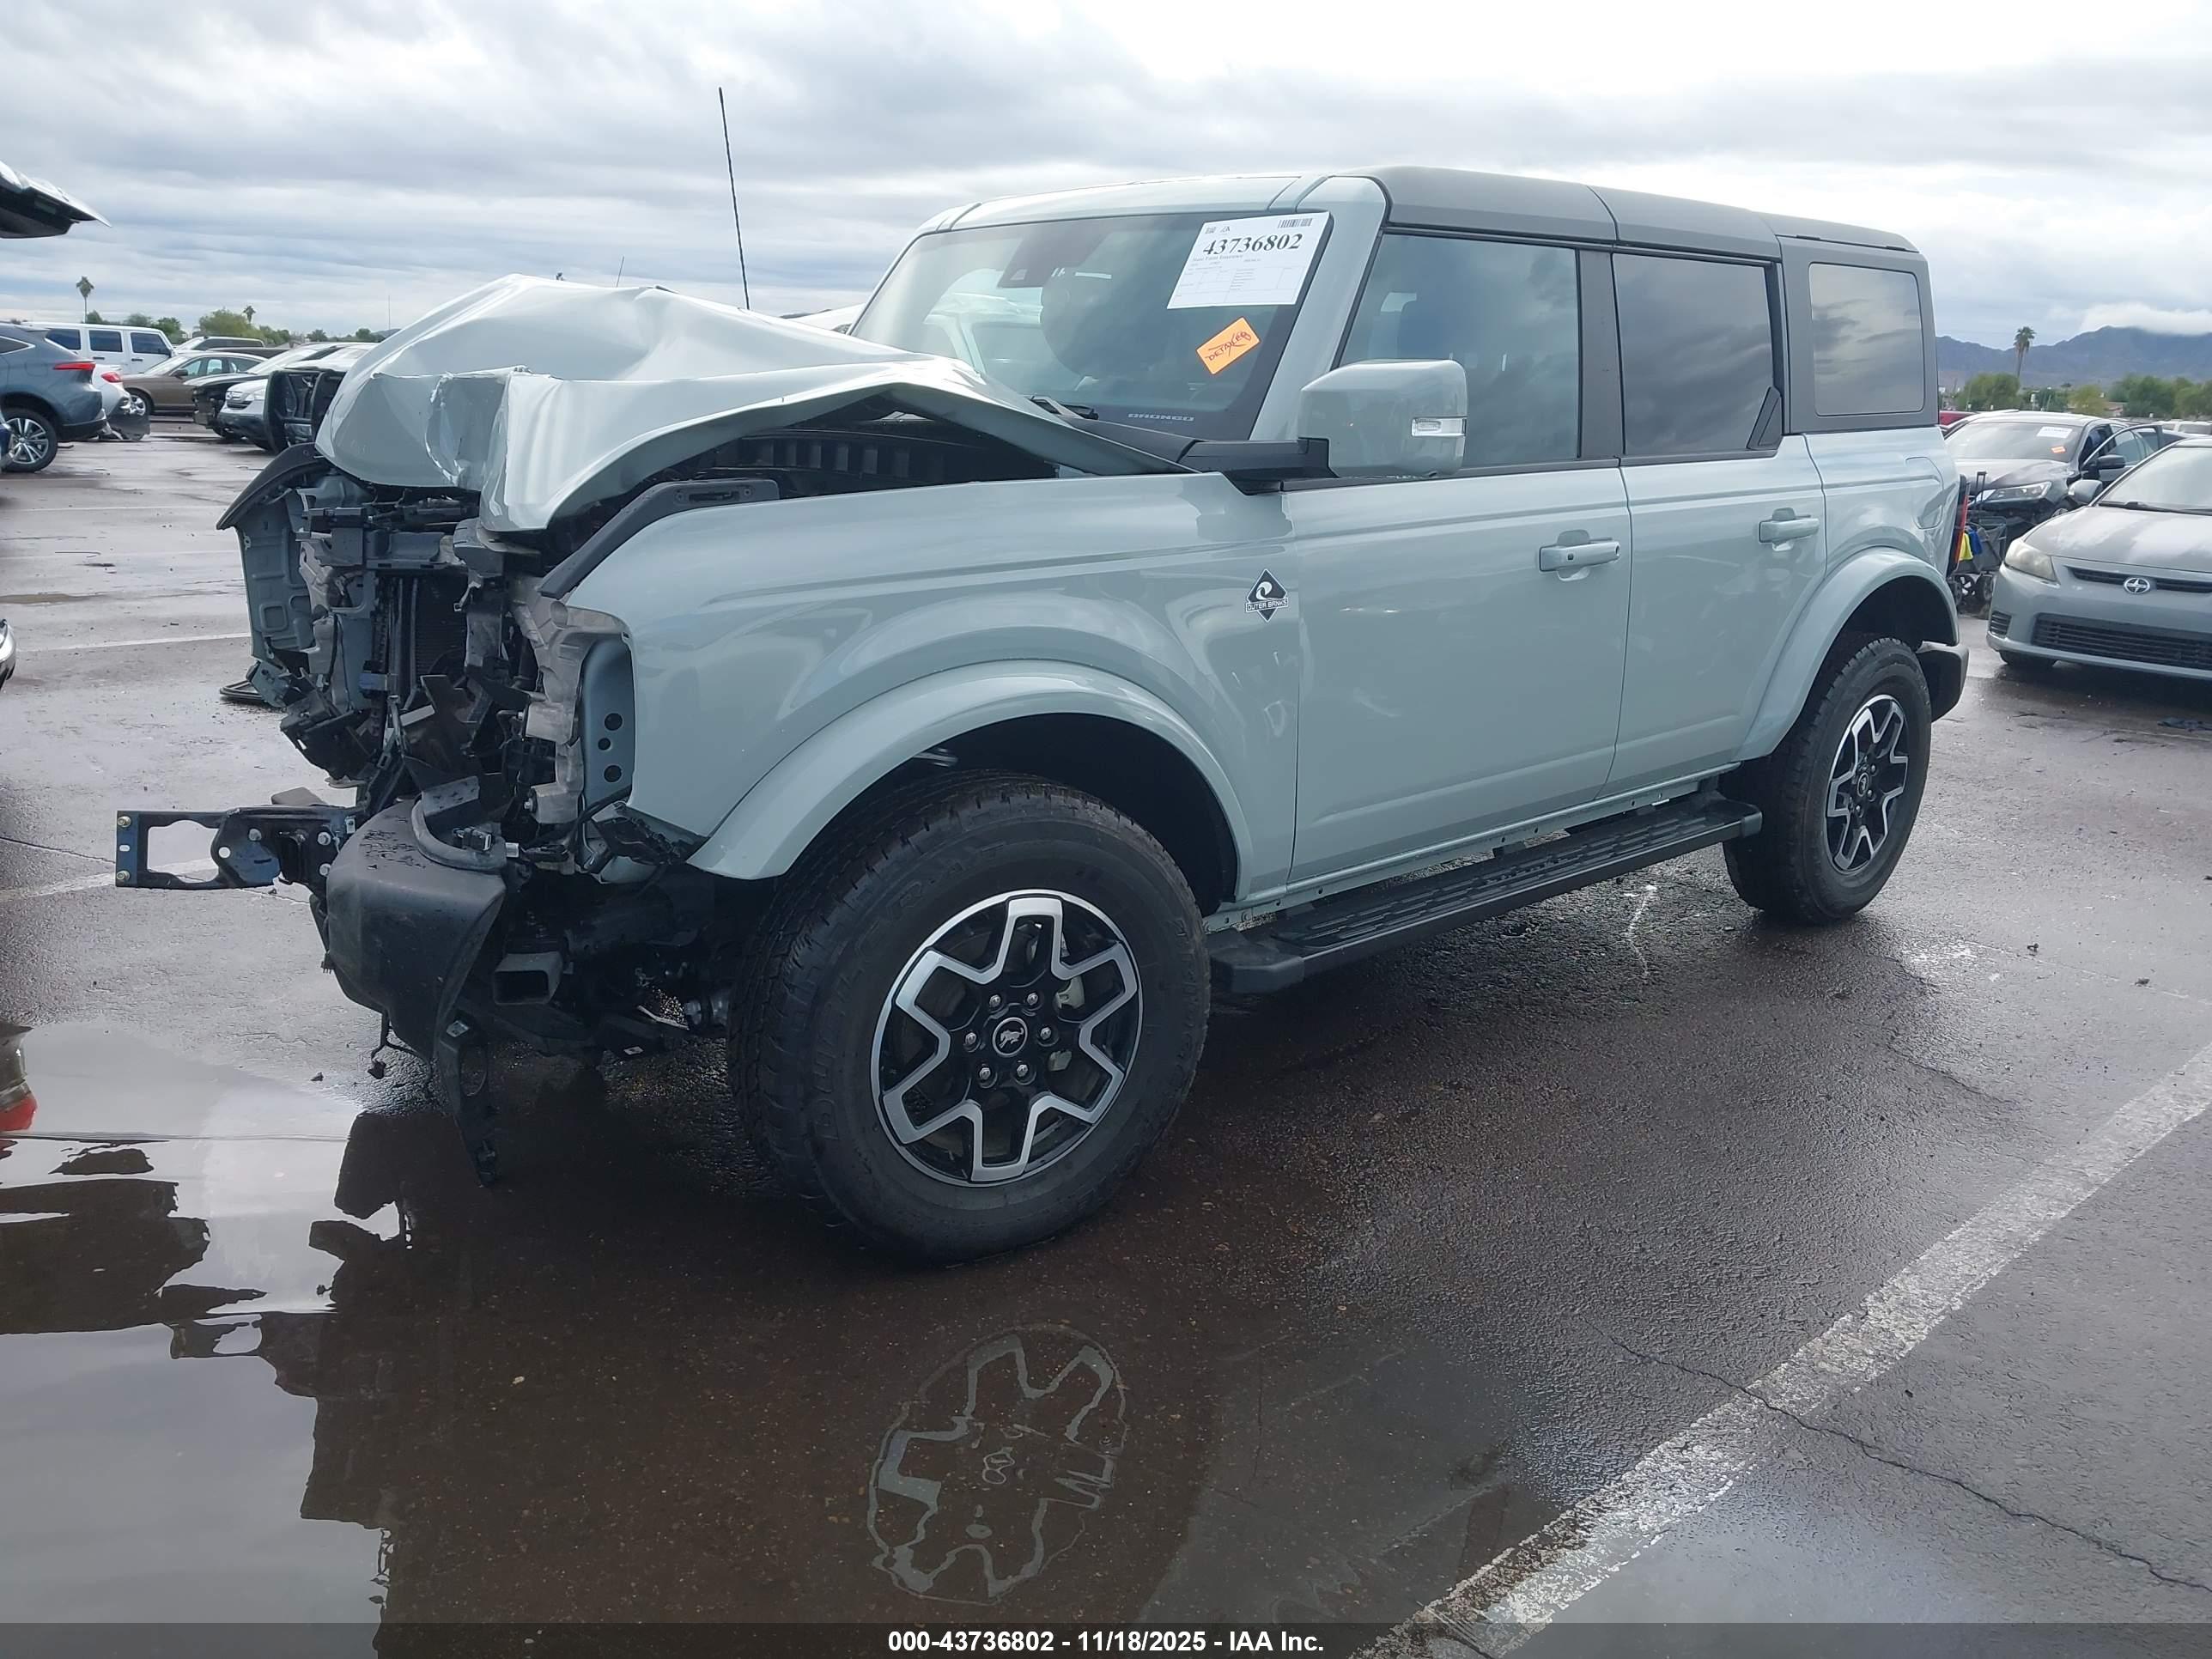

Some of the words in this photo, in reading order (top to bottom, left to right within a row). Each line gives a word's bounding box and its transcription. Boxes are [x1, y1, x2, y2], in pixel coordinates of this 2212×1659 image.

[1203, 233, 1303, 255] 43736802
[1127, 413, 1194, 422] BRONCO
[1247, 602, 1267, 611] OUTER
[1267, 599, 1287, 608] BANKS
